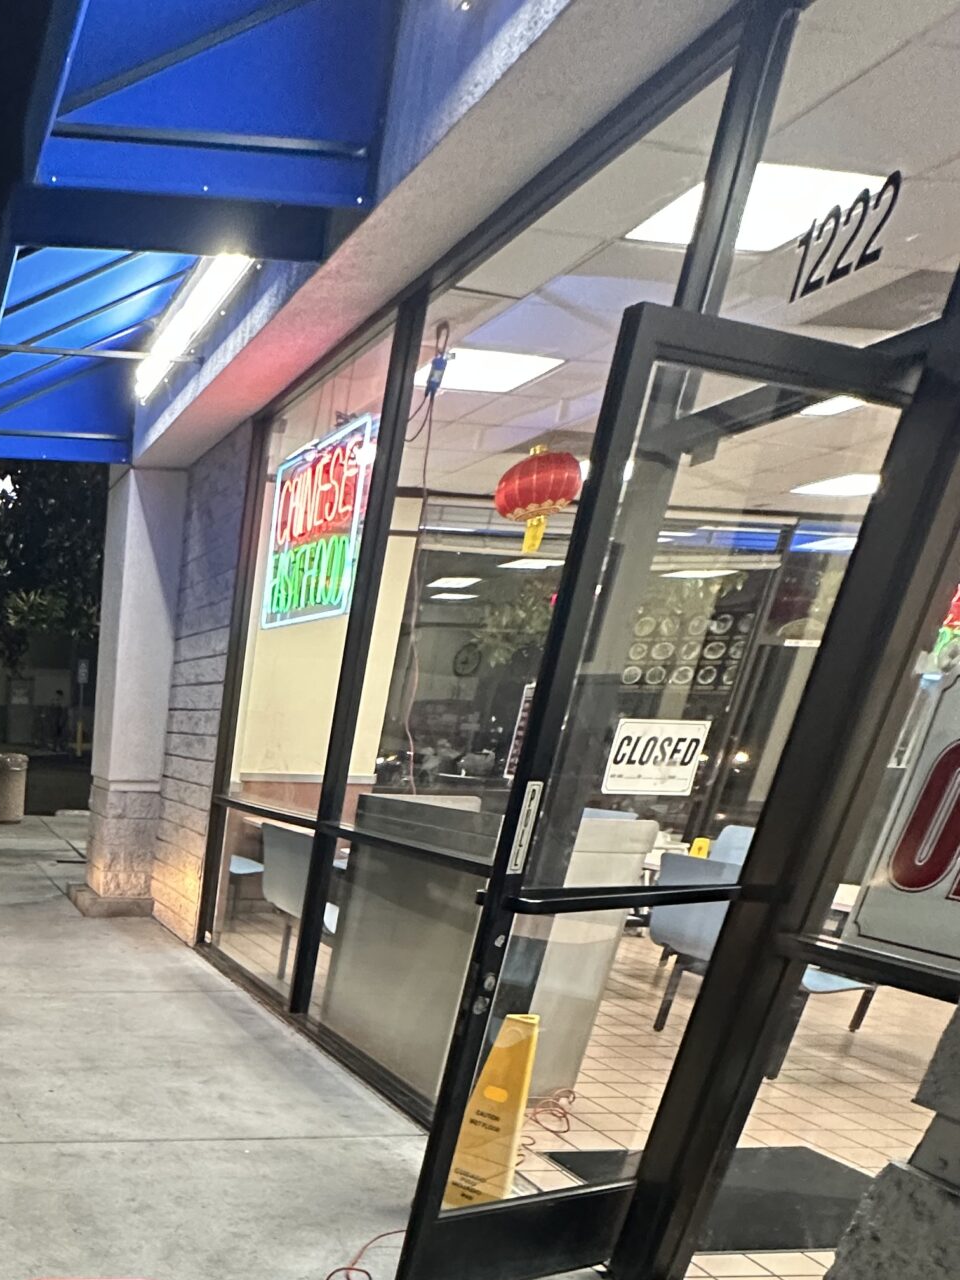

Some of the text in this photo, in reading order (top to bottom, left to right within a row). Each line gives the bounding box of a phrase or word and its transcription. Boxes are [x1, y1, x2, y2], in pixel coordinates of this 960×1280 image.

[789, 170, 902, 304] 1222
[277, 437, 362, 545] CHINESE
[613, 735, 701, 766] CLOSED
